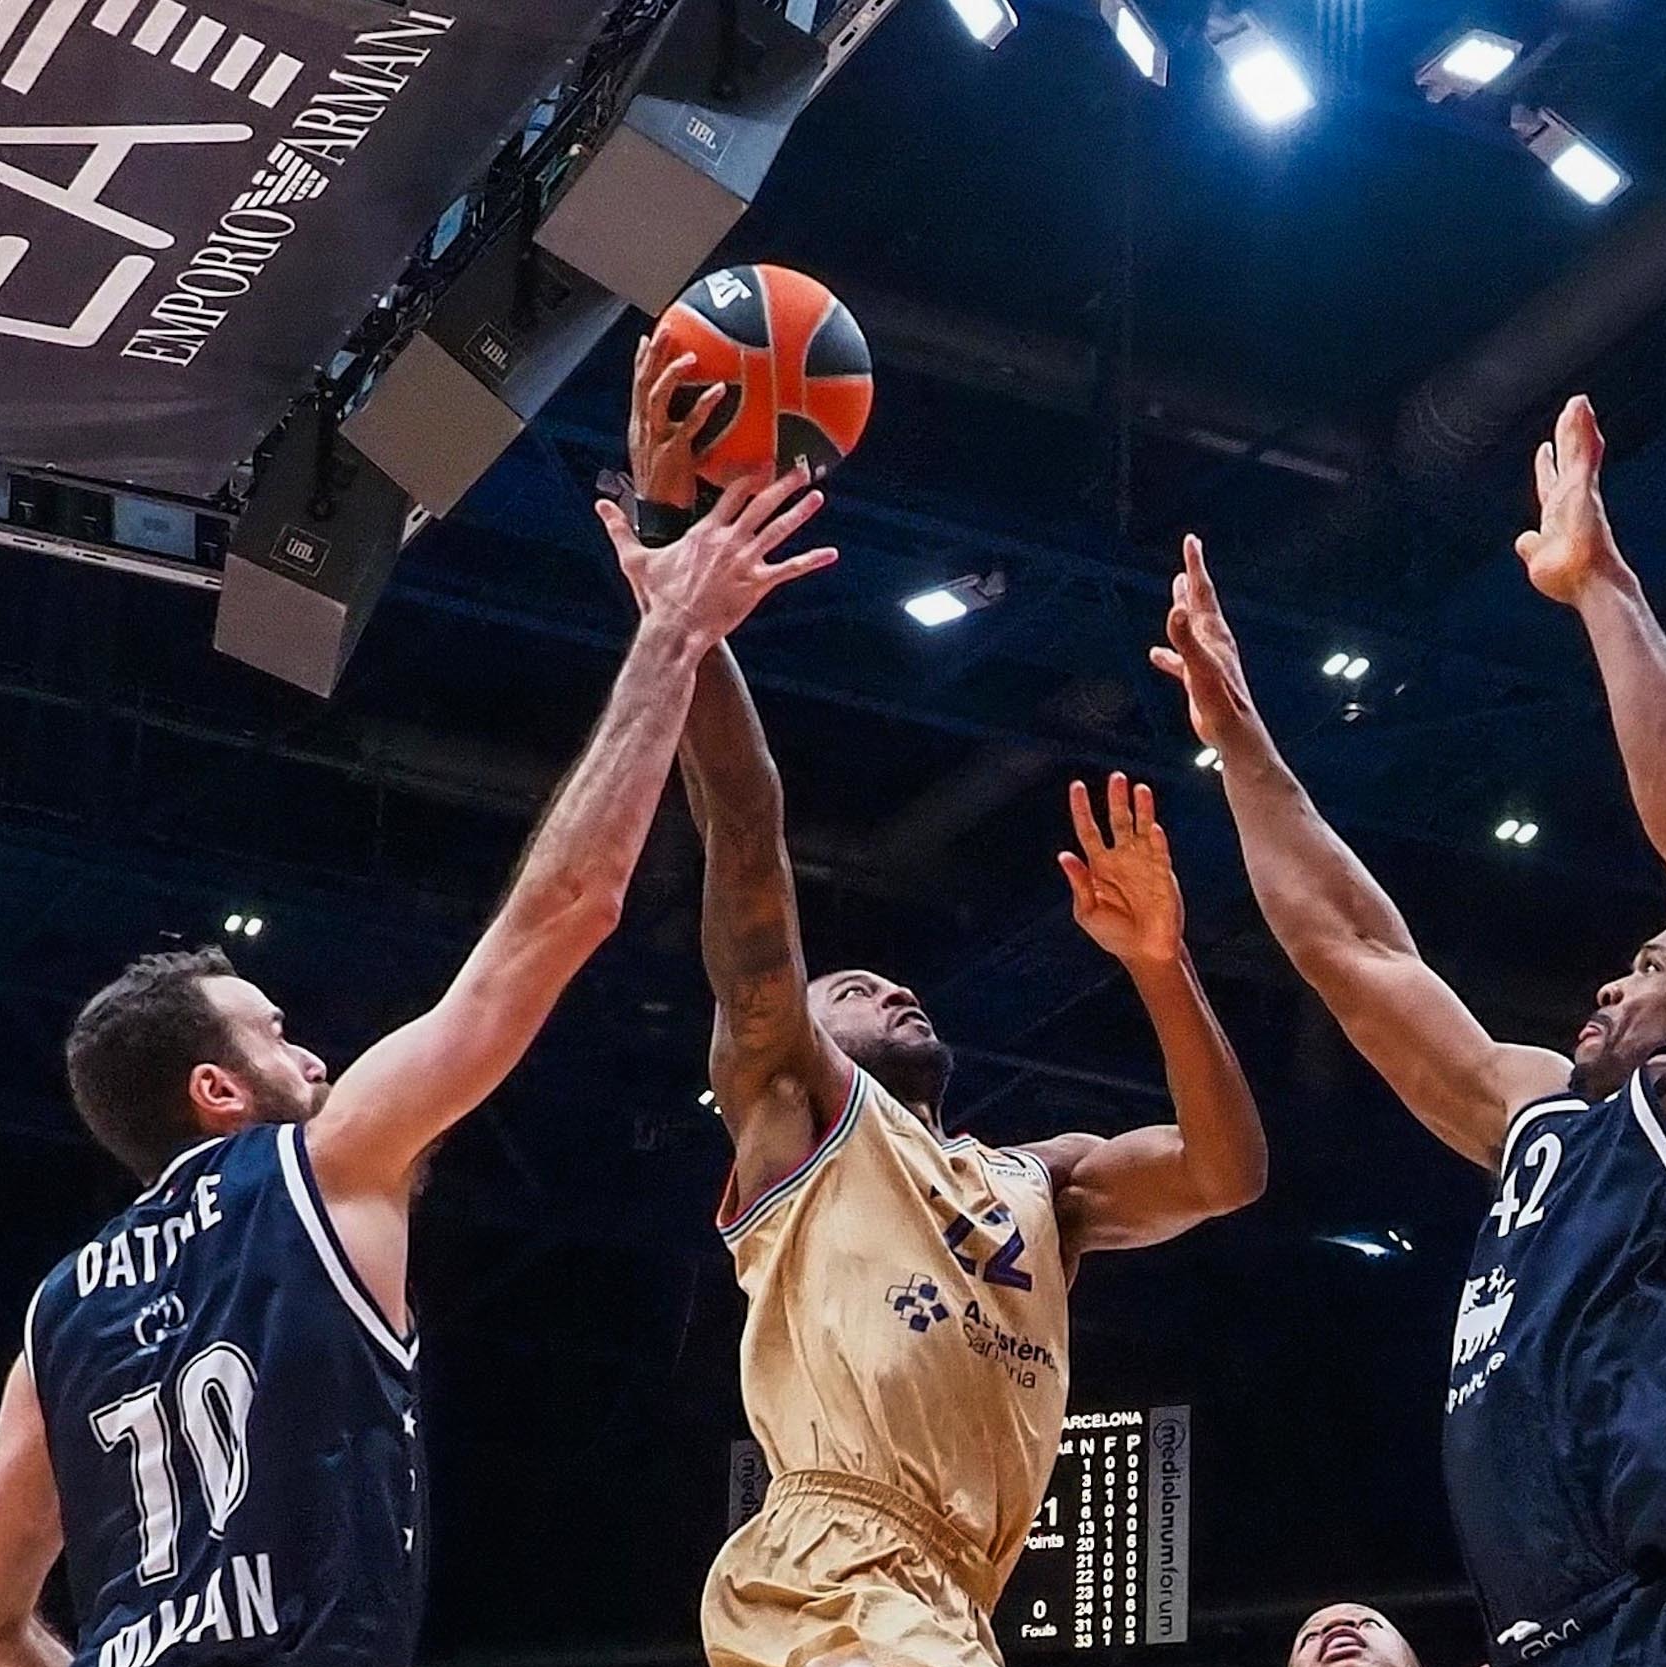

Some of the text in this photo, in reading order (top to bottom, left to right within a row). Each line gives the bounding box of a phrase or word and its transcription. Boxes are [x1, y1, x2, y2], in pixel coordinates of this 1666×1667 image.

[119, 9, 457, 367] EMPORIO ARMANI
[1061, 1411, 1143, 1431] ARCELONA
[1079, 1437, 1095, 1456] N
[1103, 1435, 1118, 1454] F
[1126, 1433, 1141, 1452] P
[1082, 1453, 1139, 1472] 1 0 0
[1104, 1471, 1116, 1487] 0
[1127, 1470, 1139, 1485] 0
[1105, 1487, 1114, 1502] 1
[1127, 1485, 1138, 1501] 0
[1103, 1503, 1115, 1518] 0
[1126, 1501, 1138, 1516] 4
[1077, 1517, 1138, 1536] 13 1 0
[1156, 1420, 1183, 1636] mediolanumforum
[1024, 1533, 1065, 1551] oints
[1075, 1536, 1095, 1552] 20
[1104, 1535, 1113, 1550] 1
[1075, 1549, 1137, 1569] 21 0 0
[1075, 1565, 1137, 1585] 22 0 0
[1075, 1582, 1137, 1601] 23 0 0
[1032, 1599, 1047, 1619] 0
[1074, 1601, 1094, 1617] 24
[1103, 1600, 1112, 1614] 1
[1020, 1623, 1057, 1638] Fouls
[1074, 1614, 1137, 1633] 31 0 0
[1074, 1633, 1094, 1649] 33
[1102, 1632, 1111, 1646] 1
